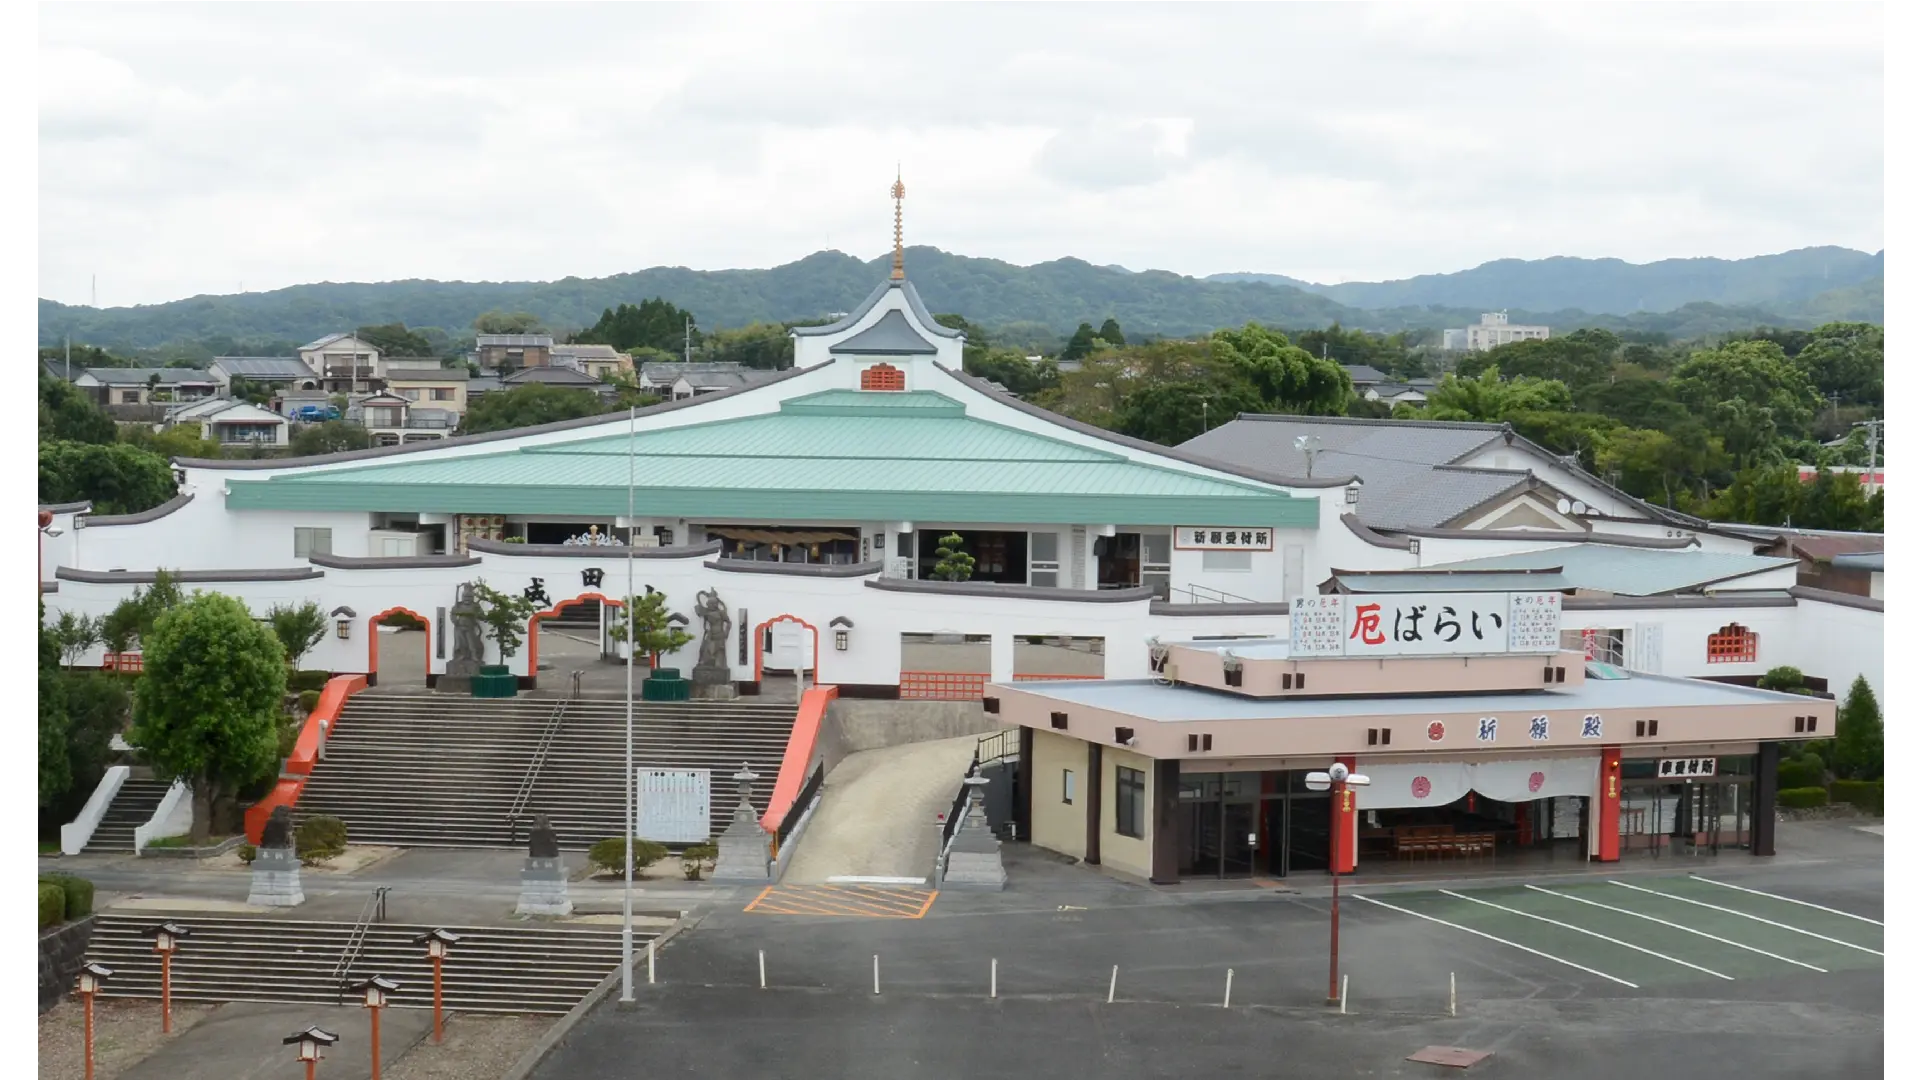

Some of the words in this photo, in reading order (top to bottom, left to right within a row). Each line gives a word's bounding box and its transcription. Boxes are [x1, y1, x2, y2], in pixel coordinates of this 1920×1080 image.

[523, 567, 667, 612] 成田
[1349, 602, 1503, 646] 厄ばらい
[1477, 714, 1601, 742] 祈願殿
